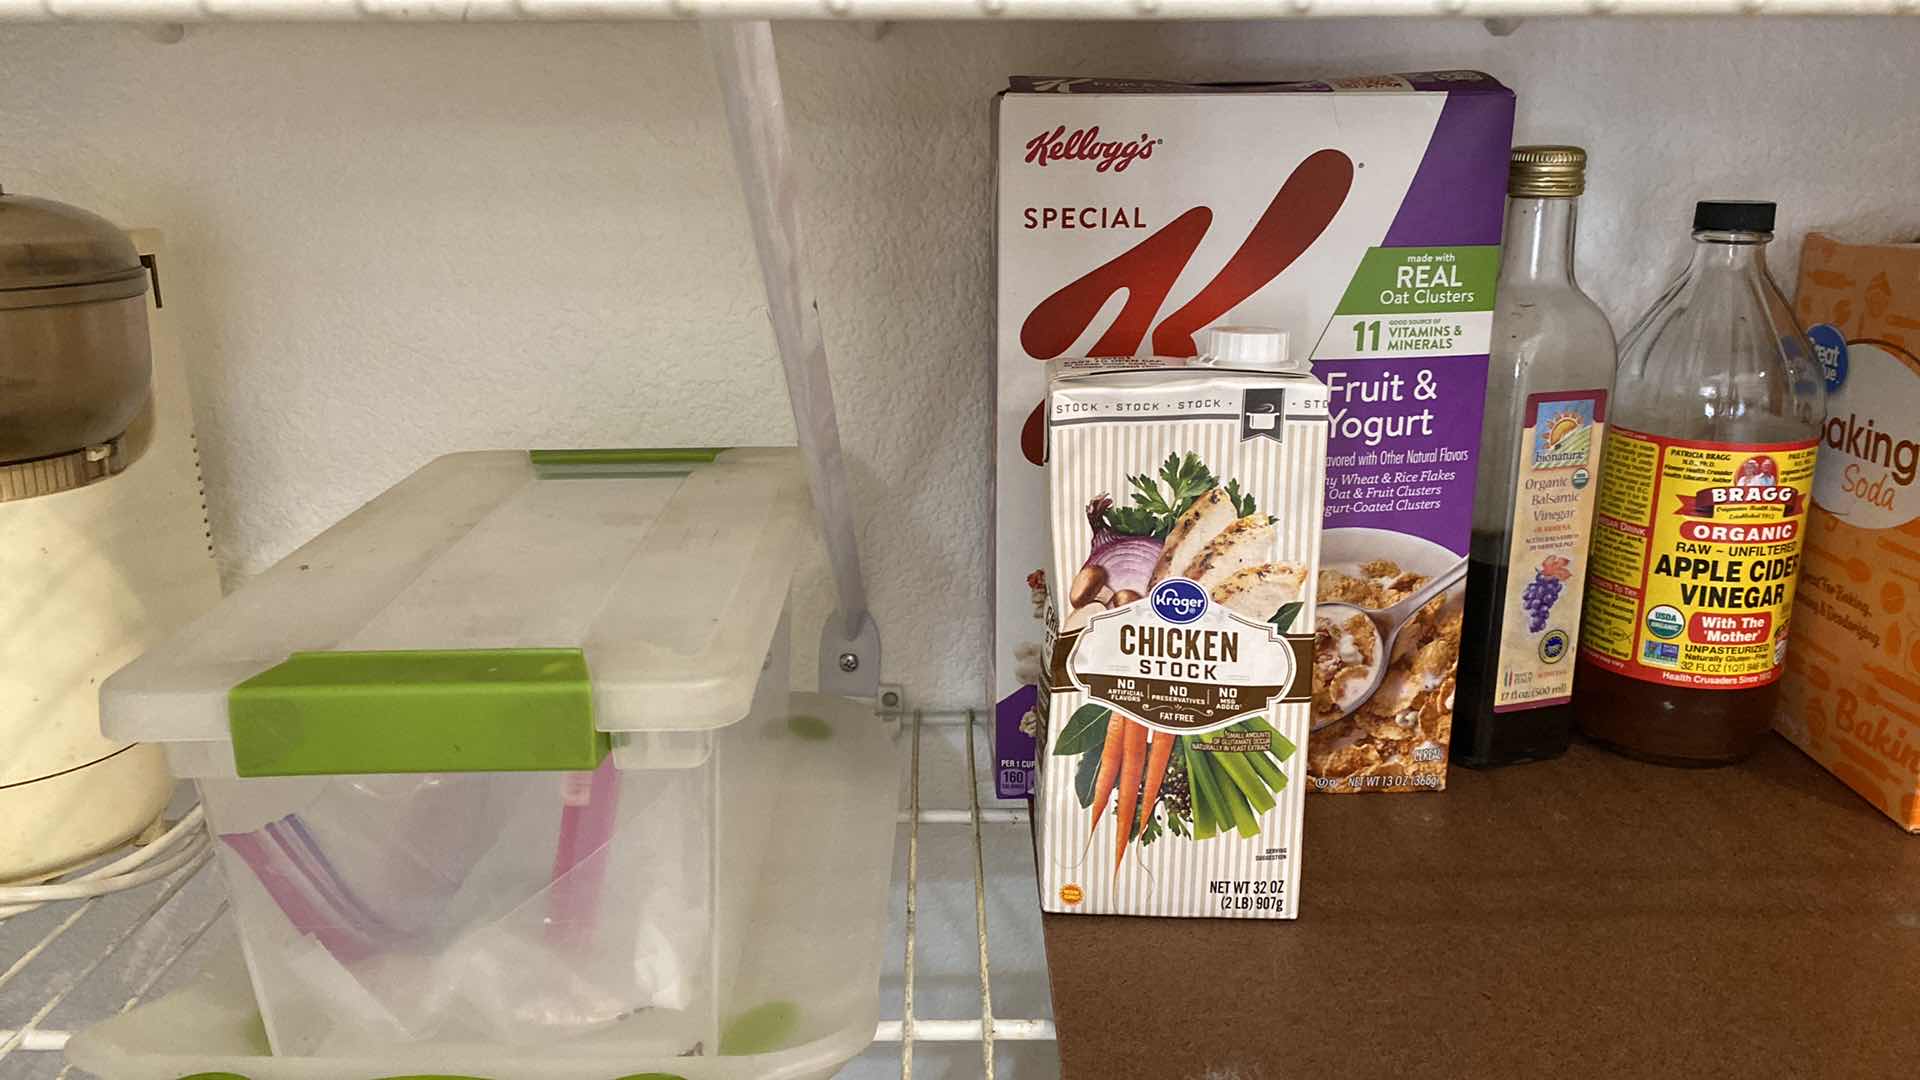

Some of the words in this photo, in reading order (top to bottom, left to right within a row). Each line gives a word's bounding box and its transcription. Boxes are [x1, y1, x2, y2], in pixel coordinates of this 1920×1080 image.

[1024, 125, 1156, 172] Kellogg's
[1023, 206, 1147, 230] SPECIAL
[1407, 253, 1434, 263] made
[1435, 252, 1456, 263] with
[1396, 264, 1463, 289] REAL
[1380, 290, 1410, 305] Oat
[1414, 289, 1475, 304] Clusters
[1352, 320, 1381, 352] 11
[1388, 325, 1450, 338] VITAMINS
[1454, 325, 1463, 337] &
[1387, 338, 1453, 351] MINERALS
[1327, 371, 1405, 403] Fruit
[1414, 369, 1438, 401] &
[1056, 402, 1098, 414] STOCK
[1116, 402, 1160, 412] STOCK
[1177, 399, 1221, 410] STOCK
[1328, 408, 1434, 446] Yogurt
[1358, 451, 1378, 466] with
[1380, 450, 1404, 465] Other
[1407, 448, 1438, 464] Natural
[1439, 447, 1469, 462] Flavors
[1670, 449, 1704, 459] PATRICIA
[1706, 452, 1731, 461] BRAGG
[1821, 413, 1920, 486] aking
[1341, 473, 1379, 486] Wheat
[1381, 473, 1392, 484] &
[1394, 472, 1418, 483] Rice
[1419, 470, 1456, 482] Flakes
[1525, 477, 1569, 491] Organic
[1329, 488, 1351, 500] Oat
[1353, 488, 1363, 499] &
[1366, 486, 1395, 498] Fruit
[1396, 485, 1442, 497] Clusters
[1841, 463, 1895, 511] Soda
[1531, 493, 1579, 506] Balsamic
[1712, 487, 1792, 503] BRAGG
[1396, 499, 1441, 512] Clusters
[1534, 510, 1576, 521] Vinegar
[1693, 525, 1793, 542] ORGANIC
[1676, 542, 1712, 555] RAW
[1654, 554, 1744, 583] APPLE
[1155, 588, 1204, 615] Kroger
[1681, 583, 1785, 608] VINEGAR
[1655, 612, 1677, 622] USDA
[1702, 616, 1737, 629] With
[1741, 616, 1765, 629] The
[1119, 624, 1239, 663] CHICKEN
[1685, 653, 1723, 663] Naturally
[1139, 659, 1218, 681] STOCK
[1680, 660, 1694, 671] 32
[1117, 679, 1136, 690] NO
[1662, 672, 1692, 683] Health
[1693, 675, 1738, 684] Crusaders
[1739, 675, 1759, 684] Since
[1107, 689, 1145, 697] ARTIFICIAL
[1169, 685, 1188, 697] NO
[1219, 688, 1238, 698] NO
[1151, 695, 1205, 705] PRESERVATIVES
[1160, 712, 1174, 721] FAT
[1175, 713, 1195, 723] FREE
[1001, 760, 1015, 768] PER
[1002, 771, 1024, 783] 160
[1349, 776, 1364, 787] NET
[1367, 775, 1381, 786] WT
[1382, 775, 1393, 786] 13
[1395, 775, 1409, 786] OZ
[1209, 881, 1231, 894] NET
[1233, 881, 1250, 894] WT
[1253, 880, 1267, 894] 32
[1270, 880, 1285, 894] OZ
[1221, 896, 1232, 910] (2
[1235, 897, 1253, 911] LB)
[1256, 897, 1283, 912] 907g
